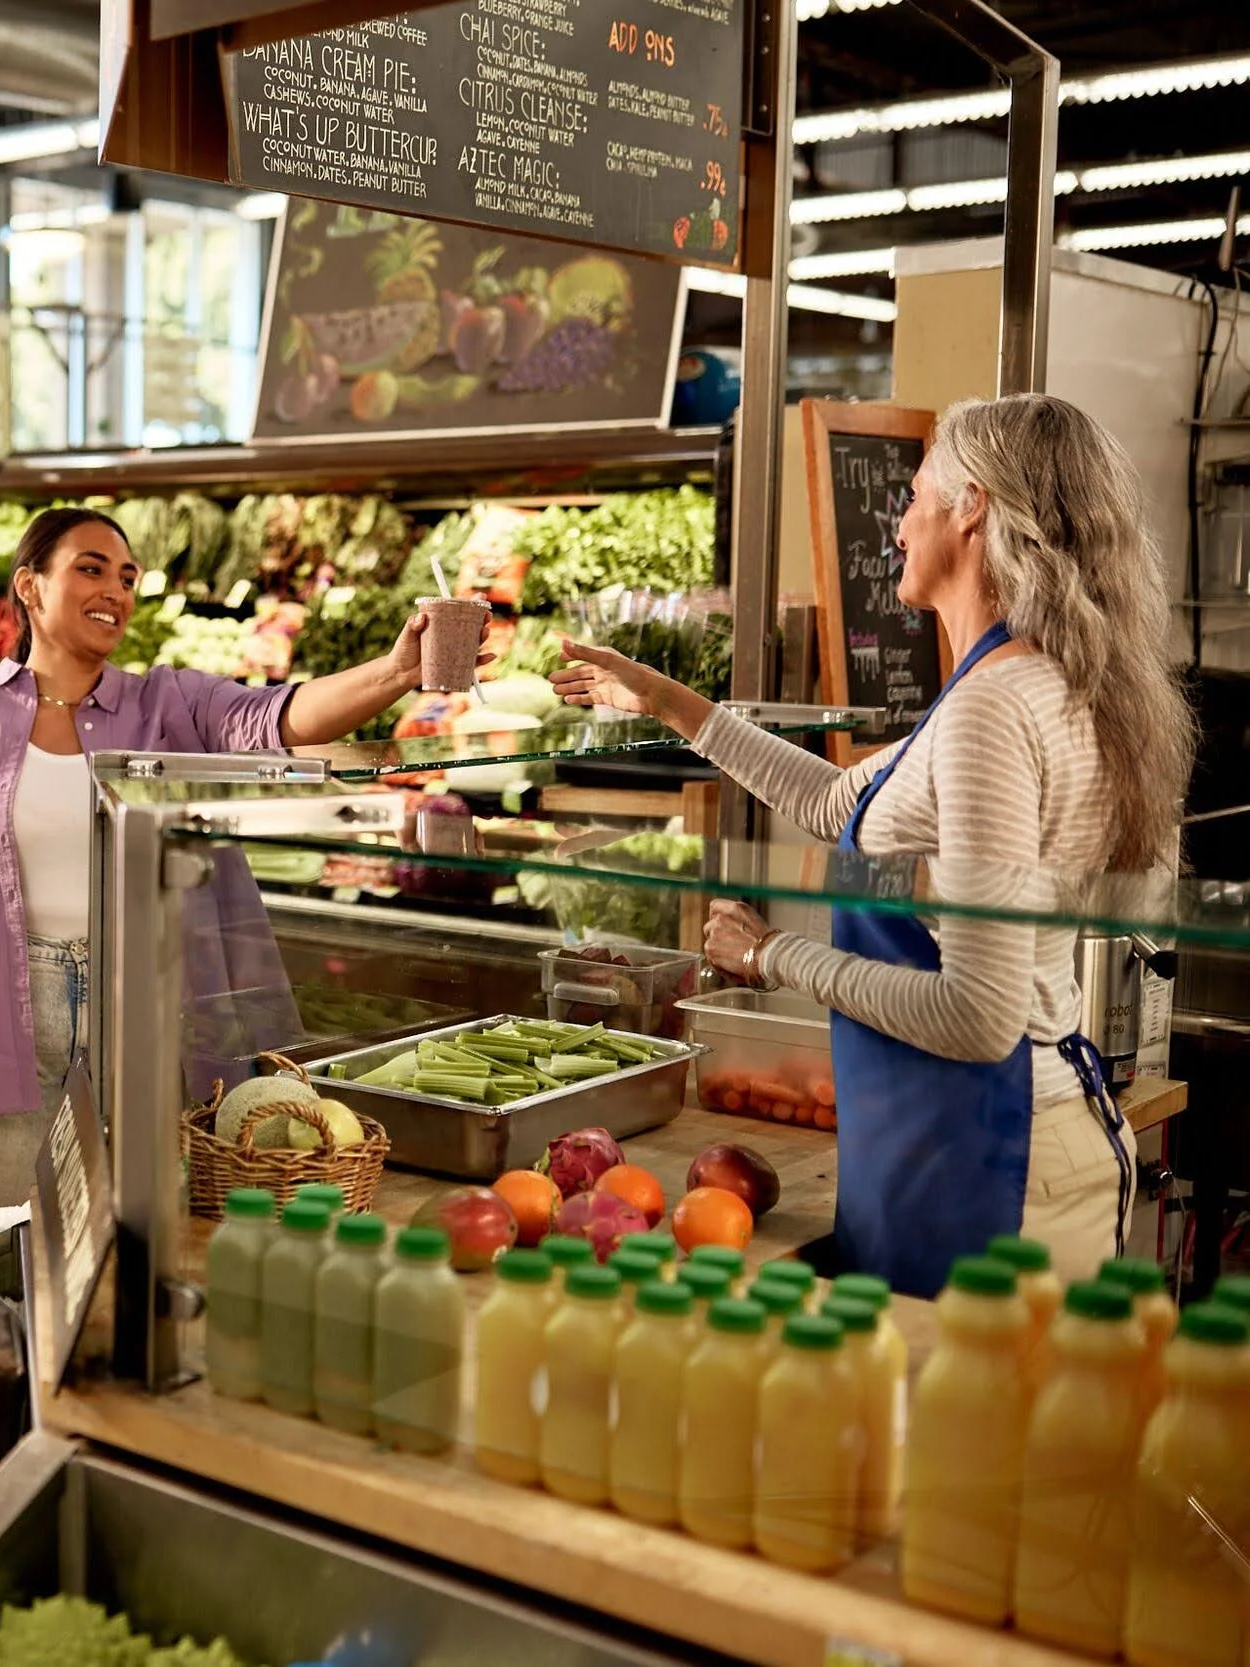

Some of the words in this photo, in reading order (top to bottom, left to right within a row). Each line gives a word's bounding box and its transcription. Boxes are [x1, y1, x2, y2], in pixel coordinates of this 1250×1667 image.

[397, 25, 428, 46] COFFEE
[460, 13, 495, 46] CHAI
[502, 23, 546, 60] SPICE:
[525, 9, 553, 31] ORANGE
[554, 19, 574, 36] JUICE
[347, 30, 369, 48] MILK
[608, 21, 638, 54] ADD
[645, 29, 675, 67] ONS
[321, 46, 376, 86] CREAM
[384, 58, 417, 94] PIE:
[394, 93, 427, 113] VANILLA
[459, 77, 514, 115] CITRUS
[521, 92, 587, 133] CLEANSE:
[547, 82, 575, 100] COCONUT
[576, 88, 598, 105] WATER
[243, 101, 308, 141] WHAT'S
[316, 114, 340, 145] UP
[316, 95, 360, 117] COCONUT
[363, 104, 395, 124] WATER
[506, 135, 540, 154] CAYENNE
[508, 119, 546, 141] COCONUT
[548, 127, 575, 148] WATER
[263, 138, 312, 160] COCONUT
[388, 159, 421, 179] VANILLA
[458, 145, 506, 178] AZTEC
[513, 155, 560, 189] MAGIC:
[353, 171, 388, 191] PEANUT
[391, 178, 427, 198] BUTTER
[475, 177, 506, 195] ALMOND
[554, 192, 580, 208] BANANA
[564, 210, 595, 228] CAYENNE
[834, 446, 871, 514] Try
[1112, 1024, 1125, 1034] 80
